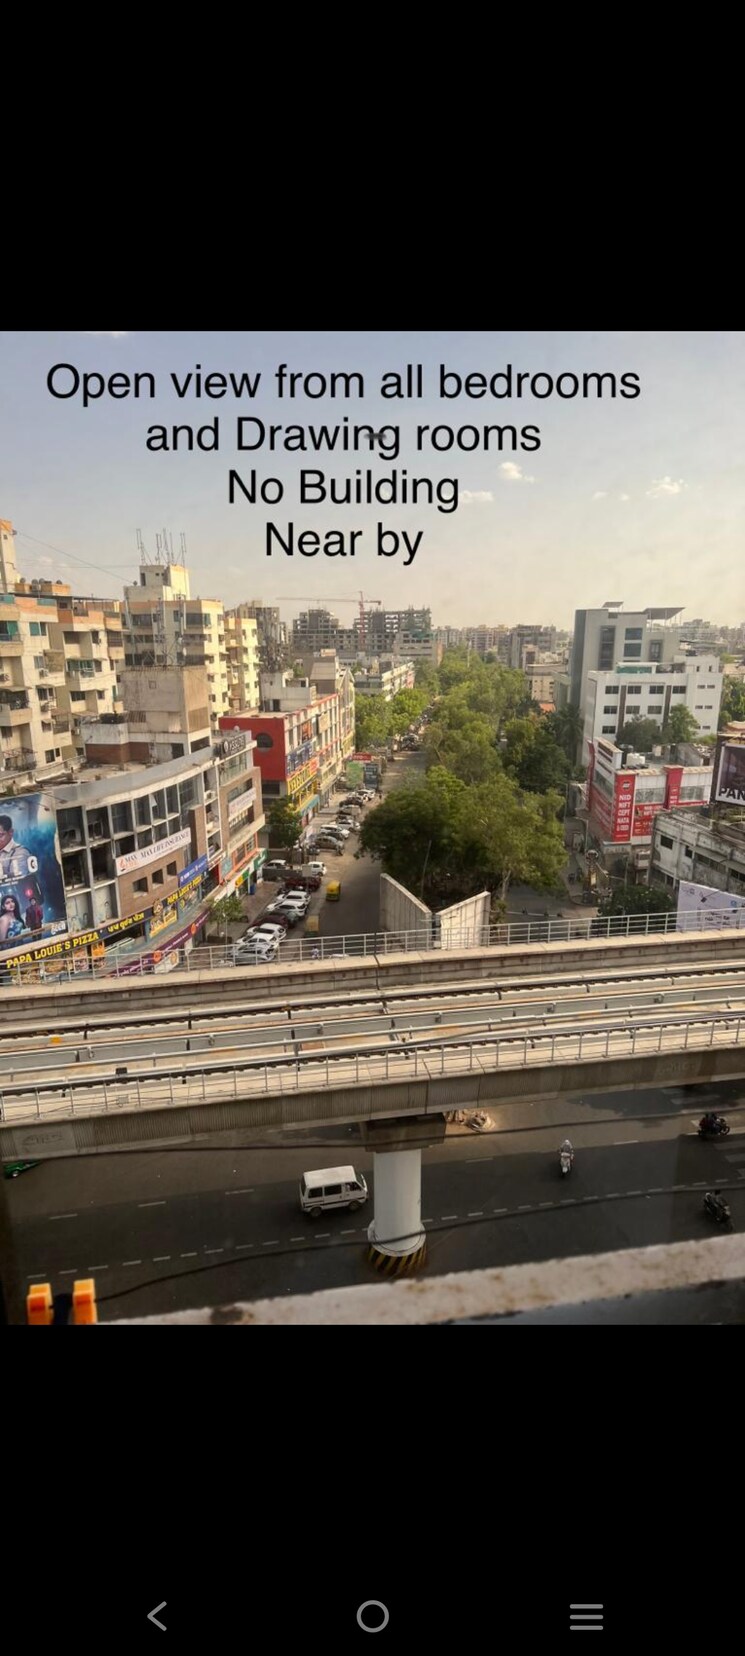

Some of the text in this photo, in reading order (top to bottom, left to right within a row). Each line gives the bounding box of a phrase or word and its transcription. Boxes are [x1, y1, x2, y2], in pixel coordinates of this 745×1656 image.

[140, 848, 153, 858] MAX
[153, 844, 164, 853] LIFE
[164, 831, 190, 848] INSURANCE
[6, 931, 99, 969] PAPA LOUIE'S PIZZA
